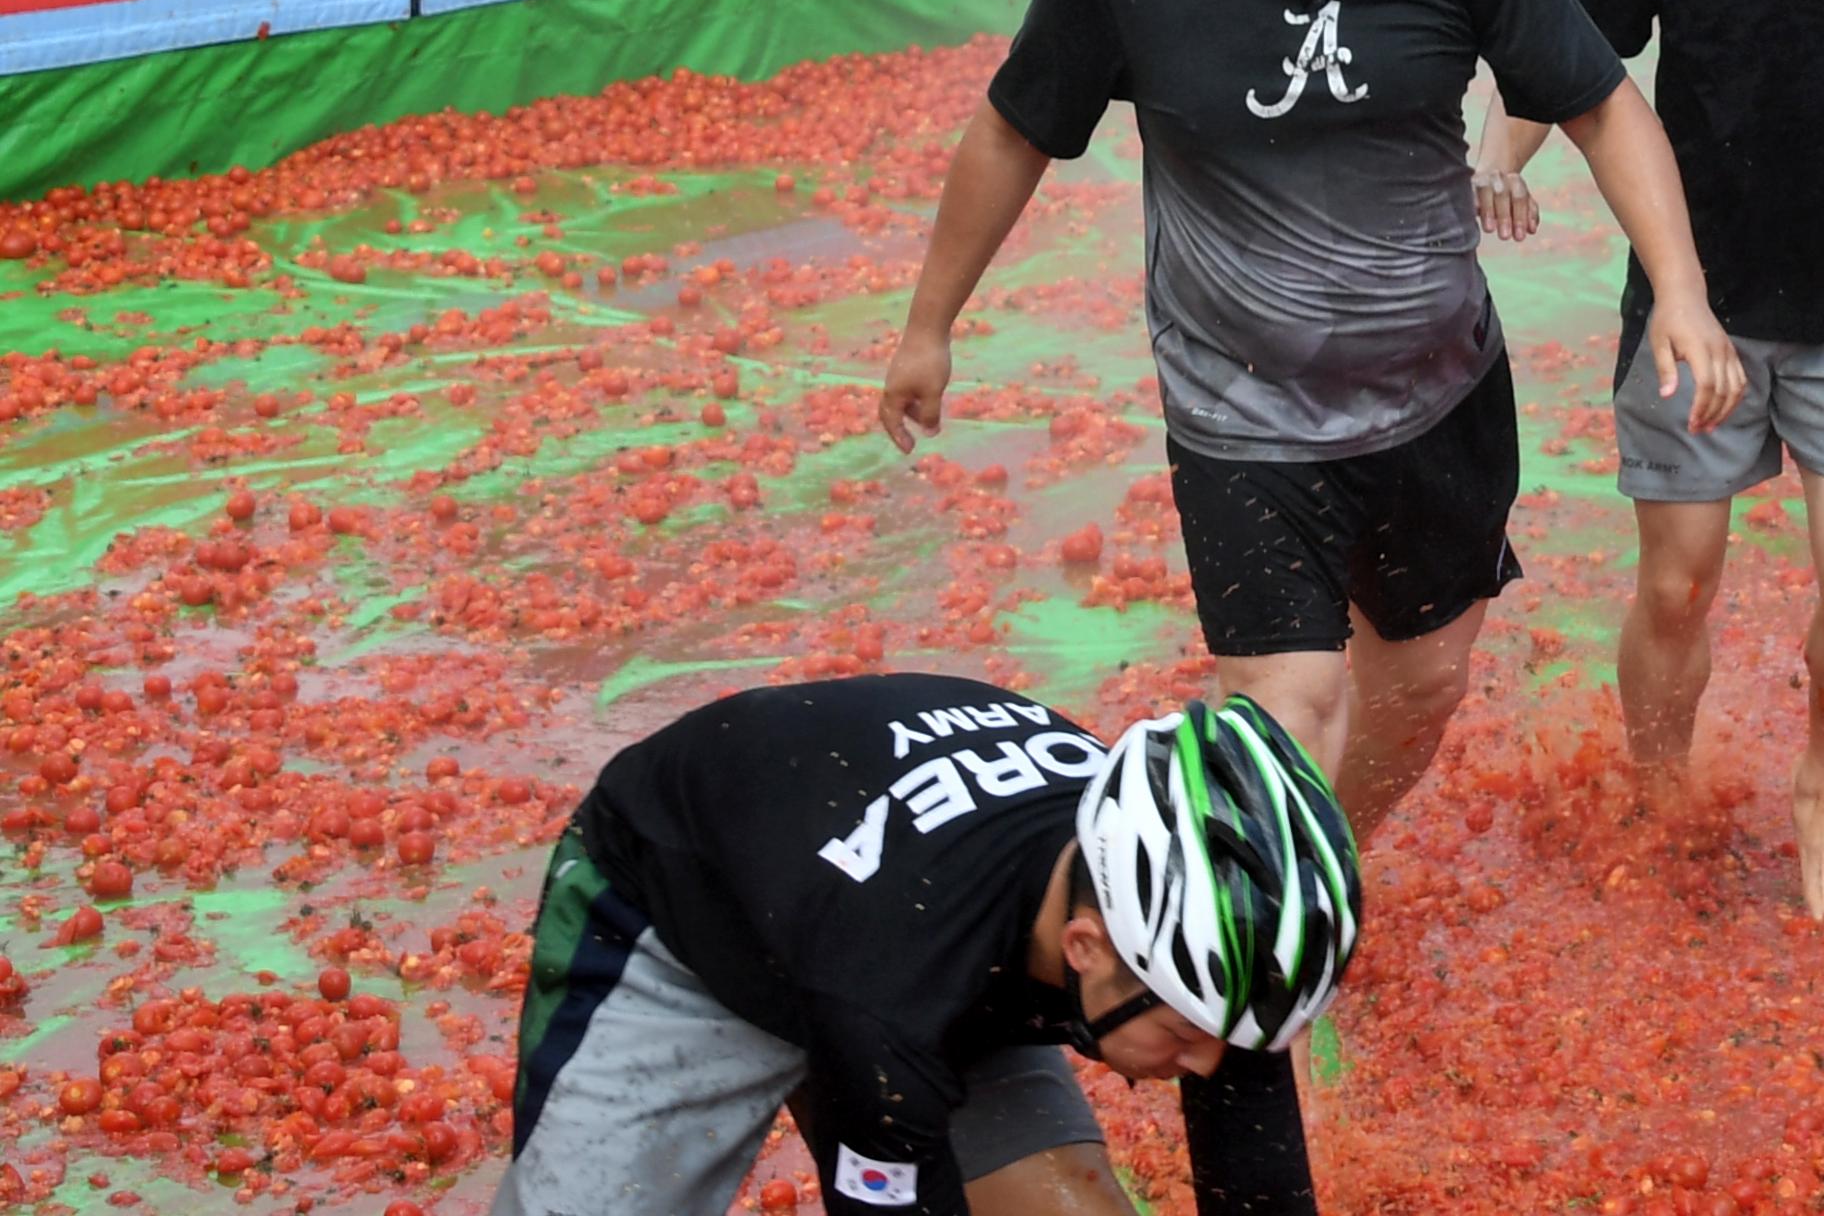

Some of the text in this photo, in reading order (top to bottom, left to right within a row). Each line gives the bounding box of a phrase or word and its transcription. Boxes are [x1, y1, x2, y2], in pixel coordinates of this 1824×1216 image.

[1245, 0, 1369, 119] A
[1646, 460, 1681, 475] ARMY
[887, 701, 1052, 760] ARMY
[816, 731, 1109, 884] OREA
